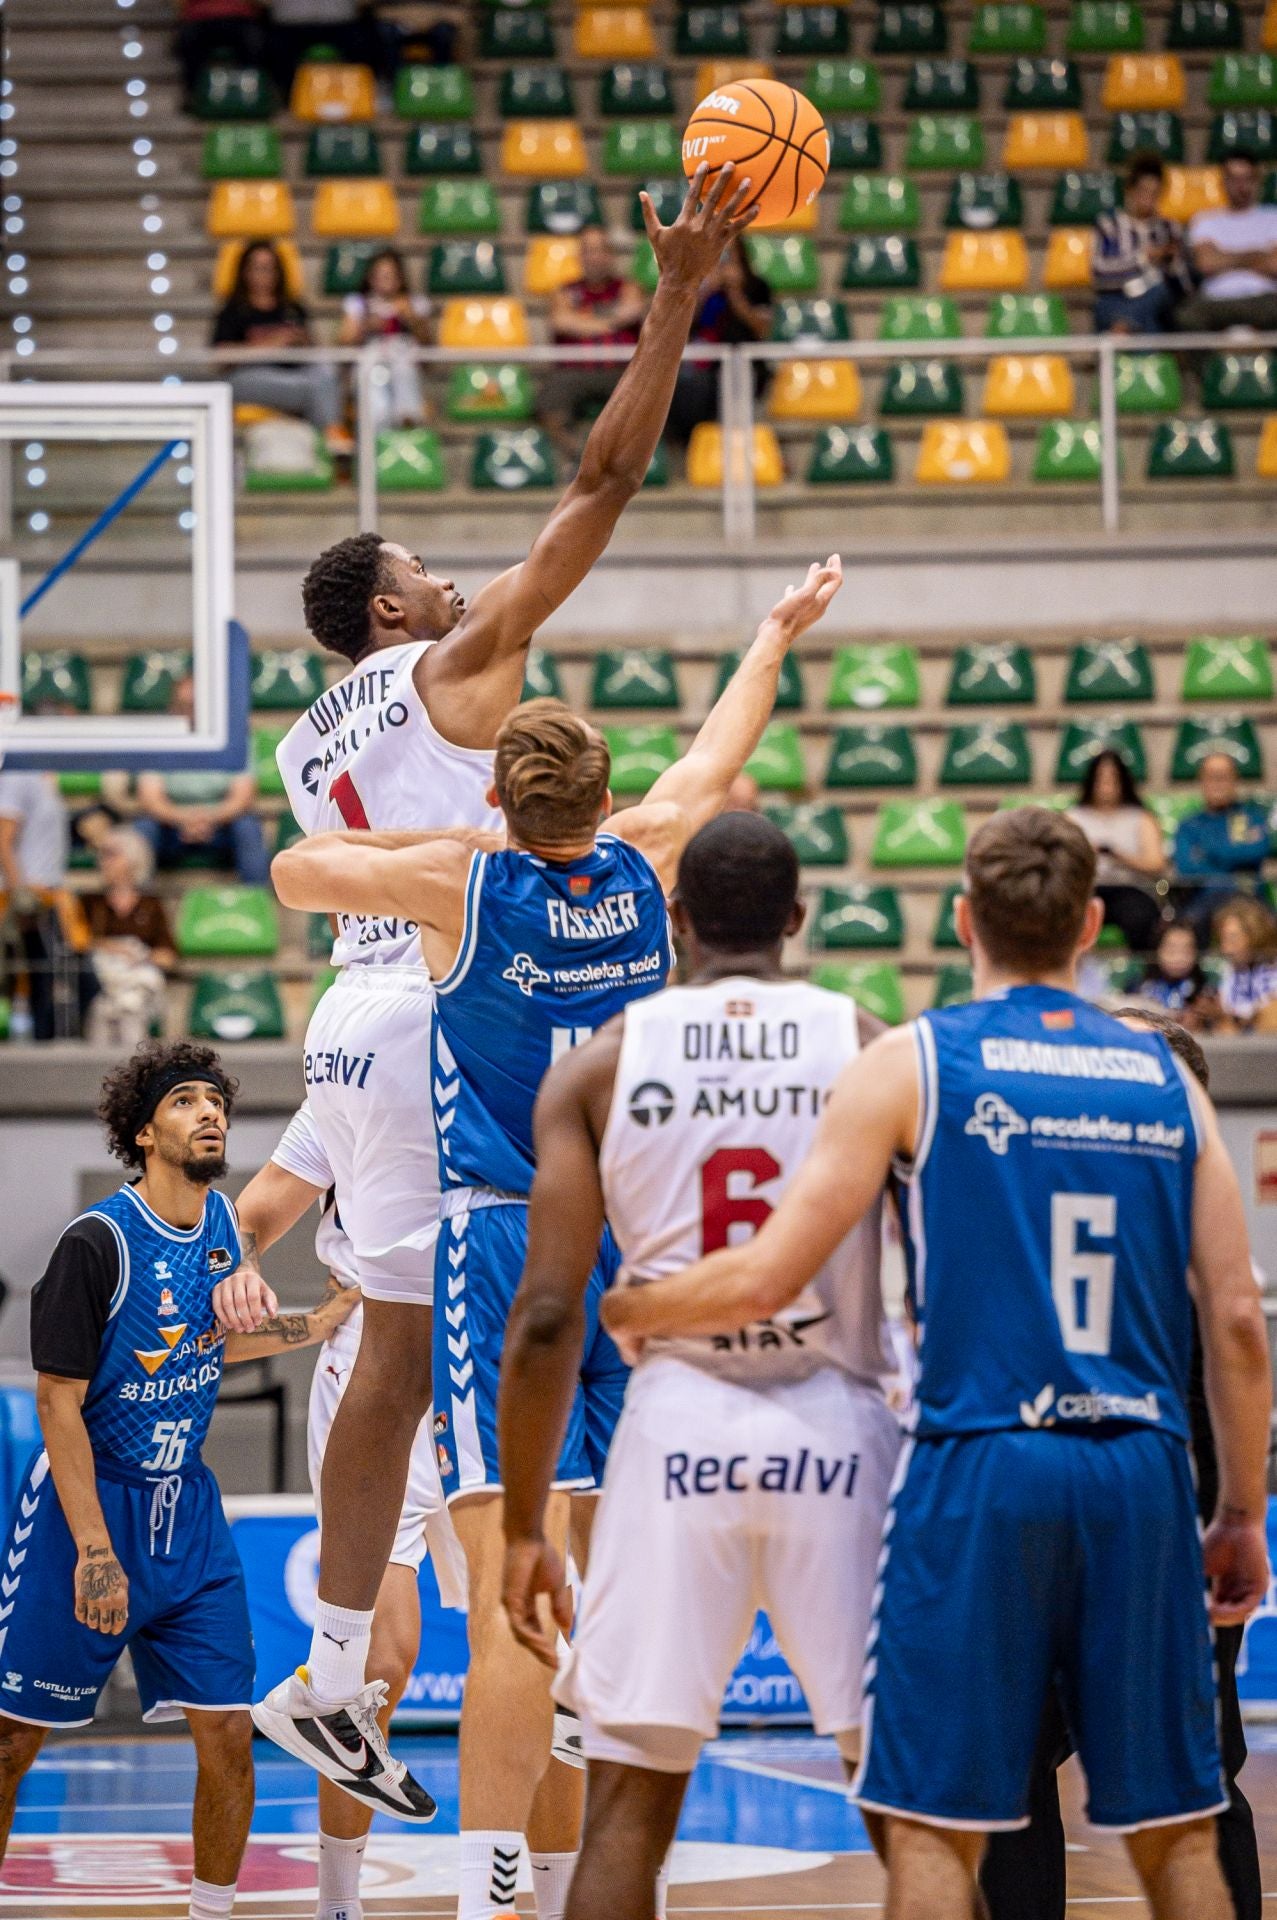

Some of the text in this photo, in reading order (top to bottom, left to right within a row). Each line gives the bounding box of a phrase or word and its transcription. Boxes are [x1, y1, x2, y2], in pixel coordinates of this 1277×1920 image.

[546, 891, 639, 940] FISCHER
[553, 950, 661, 984] recoletas salud
[684, 1021, 799, 1061] DIALLO
[303, 1046, 376, 1090] ecalvi
[690, 1086, 833, 1118] AMUTI
[1030, 1113, 1133, 1142] recoletas
[1051, 1191, 1118, 1357] 6
[141, 1418, 193, 1472] 56
[664, 1448, 860, 1500] Recalvi
[33, 1679, 71, 1694] CASTILLA
[74, 1687, 81, 1696] Y
